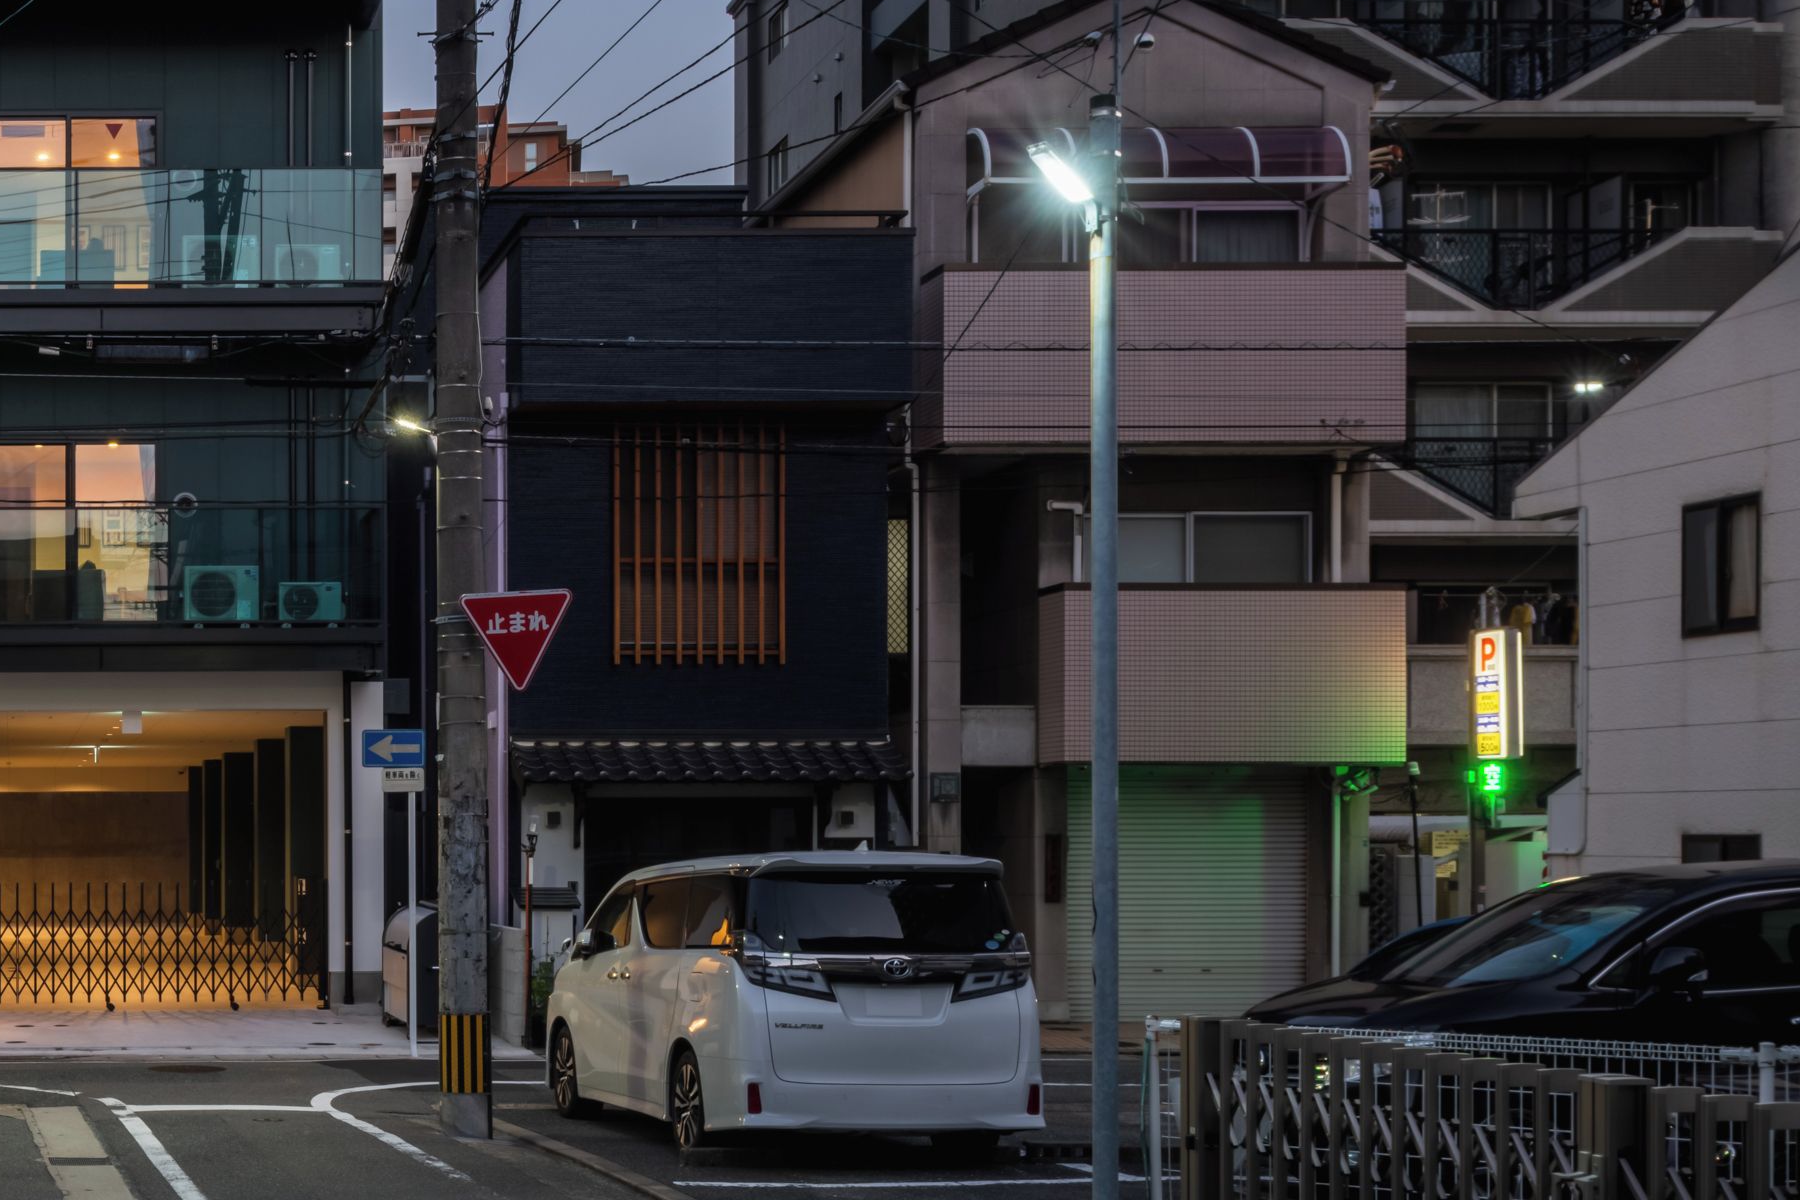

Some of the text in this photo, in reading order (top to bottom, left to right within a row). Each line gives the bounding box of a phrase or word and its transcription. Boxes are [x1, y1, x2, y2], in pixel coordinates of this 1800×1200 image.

[486, 611, 550, 634] 止まれ
[1481, 637, 1496, 672] P
